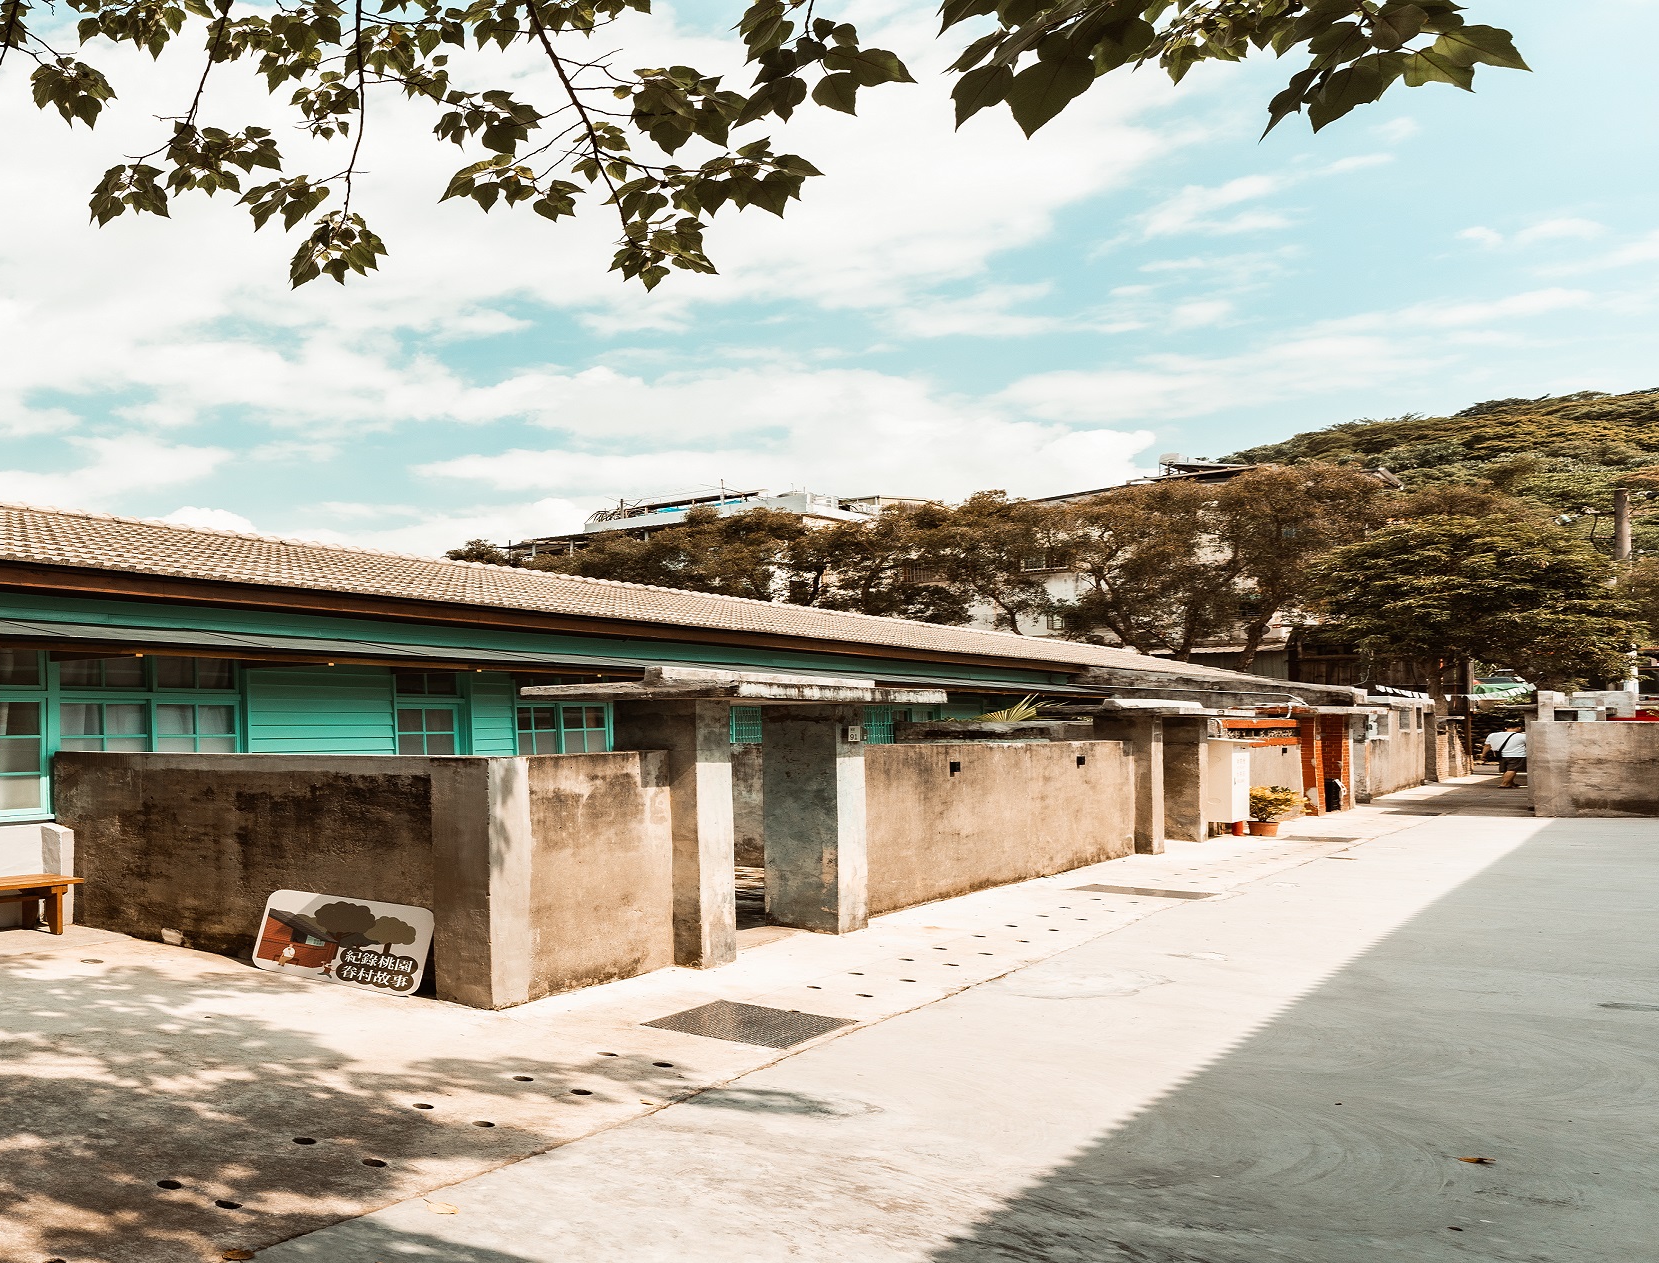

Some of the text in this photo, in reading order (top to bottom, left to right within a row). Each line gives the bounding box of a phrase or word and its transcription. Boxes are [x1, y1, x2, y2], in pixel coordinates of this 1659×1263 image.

[345, 950, 413, 973] 紀錄桃園
[341, 965, 409, 987] 眷村故事
